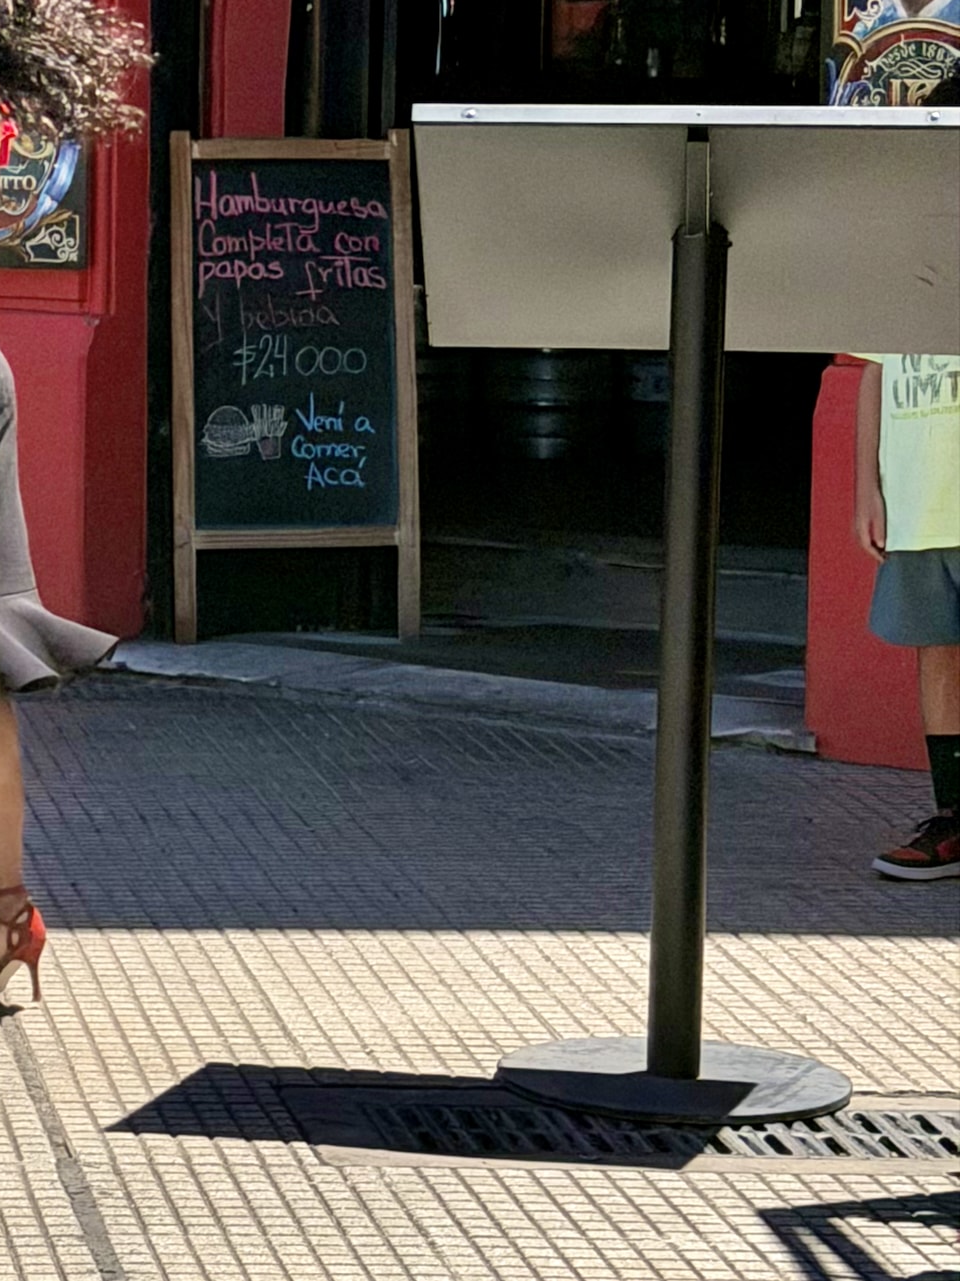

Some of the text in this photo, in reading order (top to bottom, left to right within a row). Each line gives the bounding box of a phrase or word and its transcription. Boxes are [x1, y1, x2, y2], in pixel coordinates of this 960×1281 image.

[195, 170, 389, 234] Hamburguesa
[334, 231, 381, 256] con
[198, 259, 285, 300] papas
[353, 416, 376, 435] a
